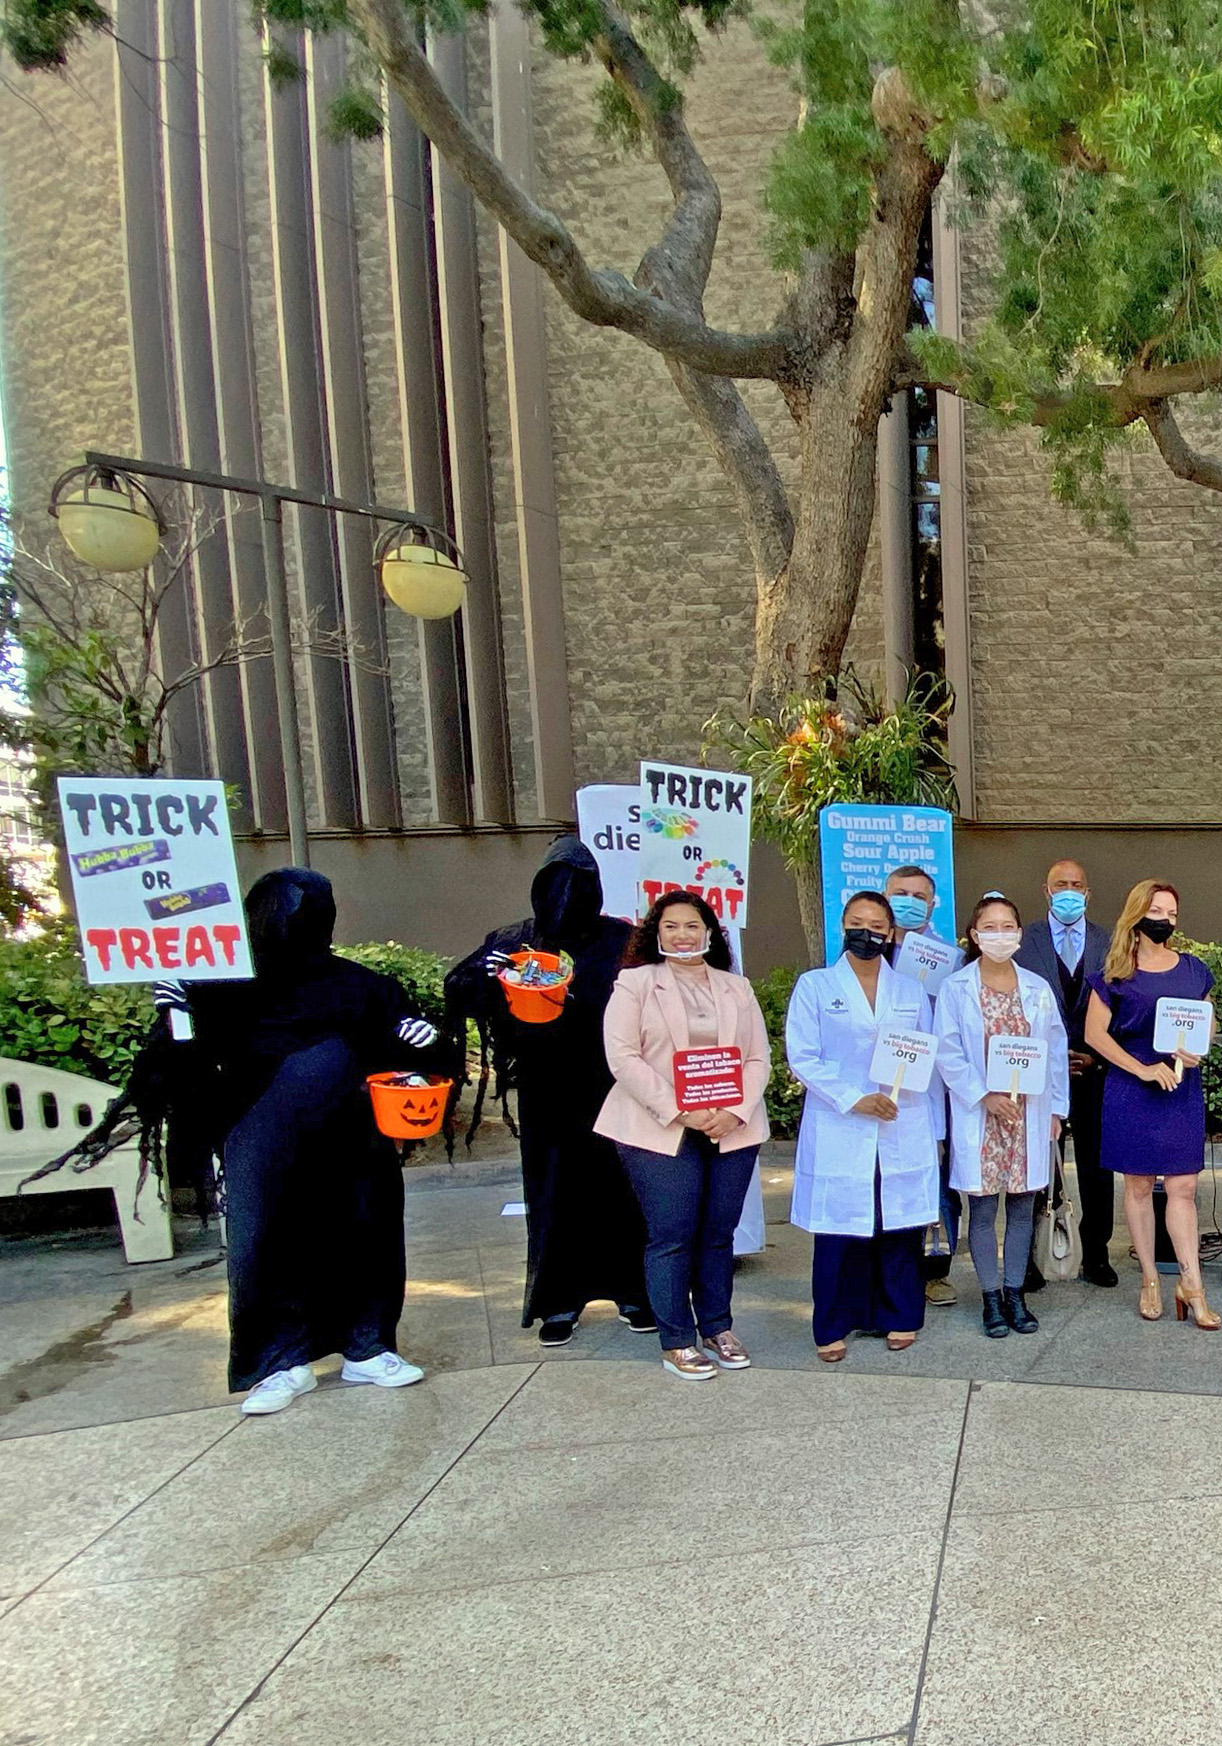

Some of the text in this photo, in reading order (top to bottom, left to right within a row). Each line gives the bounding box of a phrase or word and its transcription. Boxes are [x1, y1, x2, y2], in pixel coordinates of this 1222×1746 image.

[646, 769, 747, 815] TRICK
[66, 792, 219, 837] TRICK
[827, 811, 947, 832] Gummi Bear
[593, 825, 640, 851] die
[847, 831, 930, 845] Orange Crush
[683, 845, 702, 860] OR
[843, 843, 935, 863] Sour Apple
[840, 862, 880, 875] Cherry
[142, 870, 172, 890] OR
[846, 876, 883, 889] Fruity
[643, 880, 744, 920] TAT
[87, 925, 241, 971] TREAT
[915, 956, 938, 970] .org
[1172, 1019, 1195, 1030] .org
[891, 1040, 903, 1049] big
[903, 1044, 930, 1055] tobacco
[901, 1035, 928, 1047] diegans
[892, 1050, 917, 1063] .org
[1005, 1057, 1029, 1069] .org
